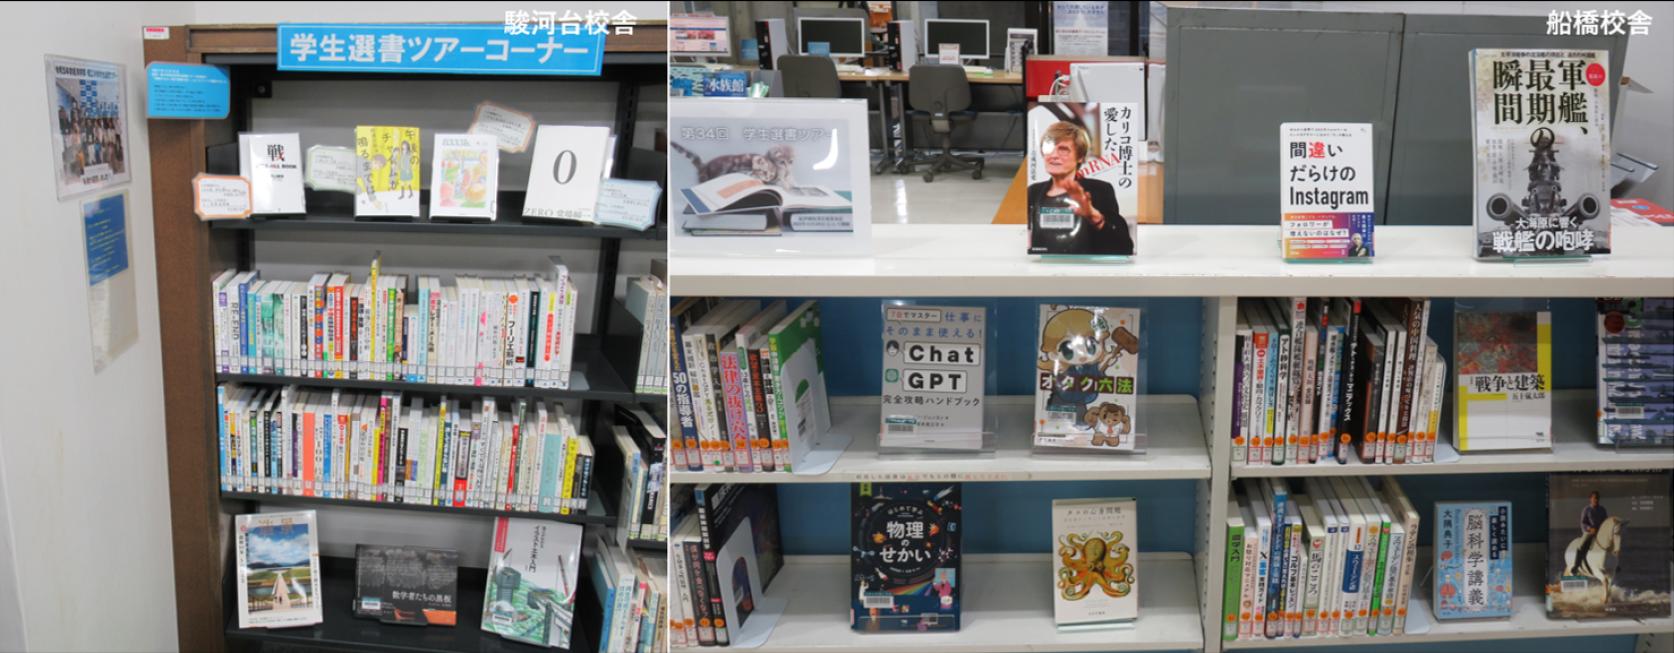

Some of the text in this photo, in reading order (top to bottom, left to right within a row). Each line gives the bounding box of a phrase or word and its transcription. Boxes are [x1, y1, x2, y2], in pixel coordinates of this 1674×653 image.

[290, 32, 589, 64] 学生選書ツアーコーナー
[708, 79, 746, 93] 水族館
[1492, 60, 1523, 125] 瞬間
[681, 127, 729, 141] 第34回
[1104, 107, 1119, 151] 愛した
[267, 144, 285, 162] 戦
[1118, 106, 1132, 189] カリコ博士の
[1290, 141, 1343, 159] 間違い
[553, 150, 577, 185] 0
[1076, 152, 1121, 179] mRNA
[1290, 164, 1356, 182] だらけの
[1290, 186, 1369, 210] Instagram
[1492, 230, 1594, 253] 戦艦の咆哮
[945, 311, 982, 323] 仕事に
[909, 344, 974, 363] Chat
[908, 372, 962, 390] GPT
[1475, 374, 1545, 393] 戦争と建築
[883, 394, 981, 407] 完全攻略ハンドブック
[887, 521, 924, 539] 物理
[901, 539, 910, 547] の
[879, 547, 931, 563] せかい
[1466, 514, 1485, 606] 脳科学講義
